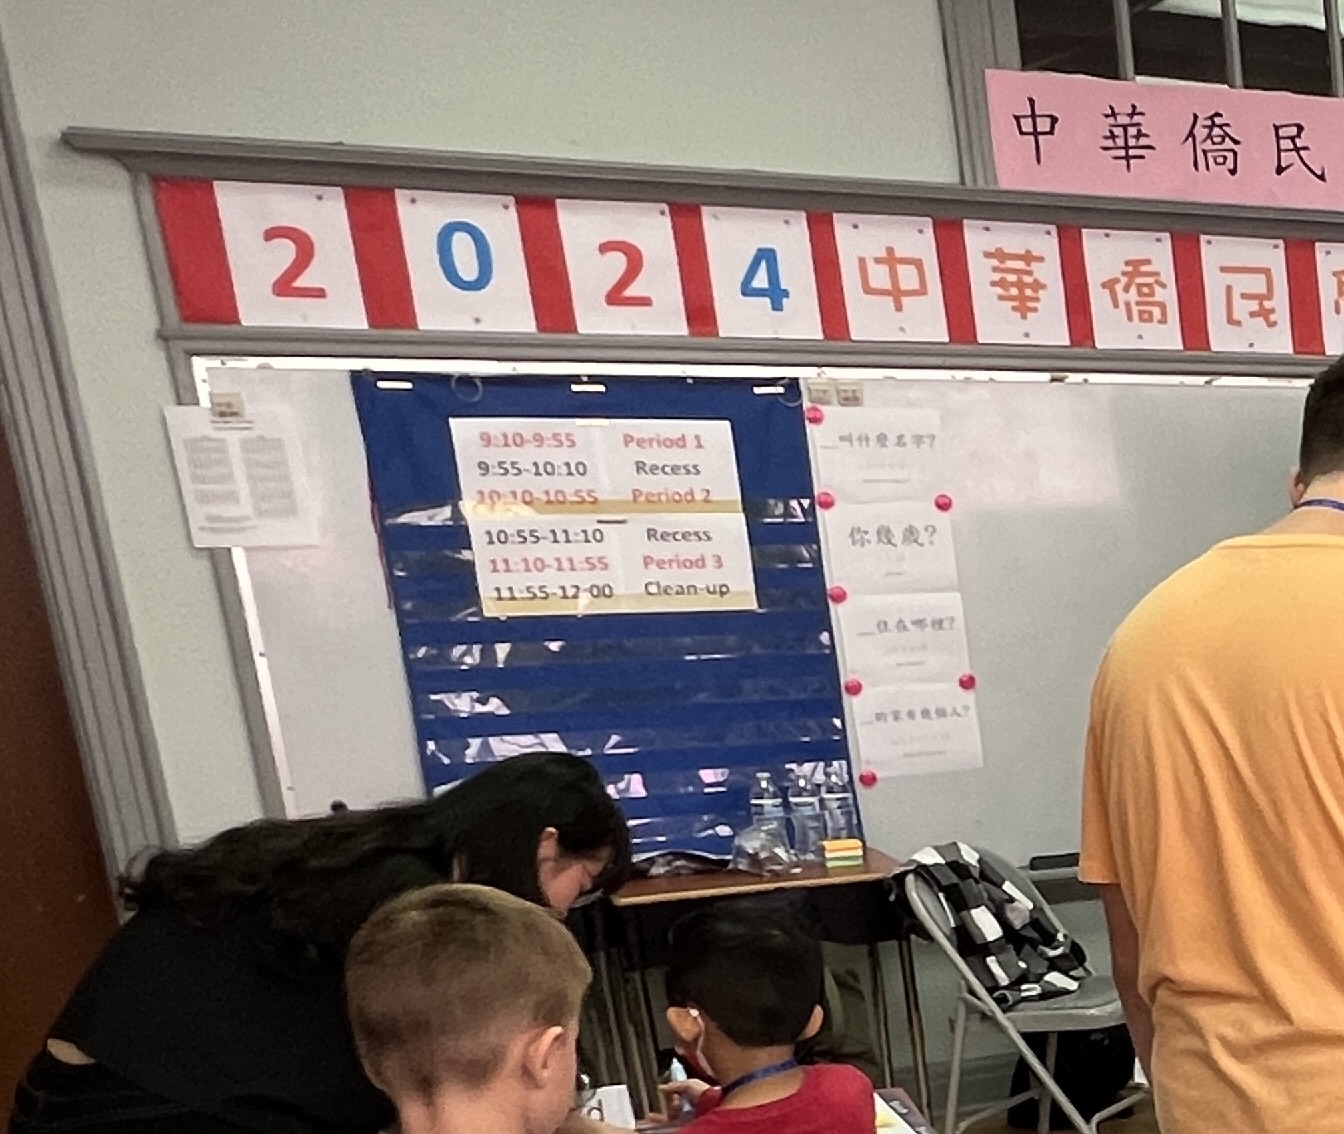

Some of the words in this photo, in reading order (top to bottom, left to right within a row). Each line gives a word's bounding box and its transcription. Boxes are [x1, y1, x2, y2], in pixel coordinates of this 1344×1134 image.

[479, 432, 577, 449] 9:10-9:55
[623, 433, 687, 450] Period
[694, 433, 705, 450] 1
[477, 460, 588, 478] 9:55-10:10
[634, 460, 702, 477] Recess
[631, 488, 697, 505] Period
[702, 488, 712, 504] 2
[485, 528, 605, 545] 10:55-11:10
[646, 528, 713, 543] Recess
[489, 555, 609, 574] 11:10-11:55
[642, 554, 706, 570] Period
[712, 554, 724, 569] 3
[493, 583, 614, 602] 11:55-12:00
[644, 580, 731, 599] Clean-up
